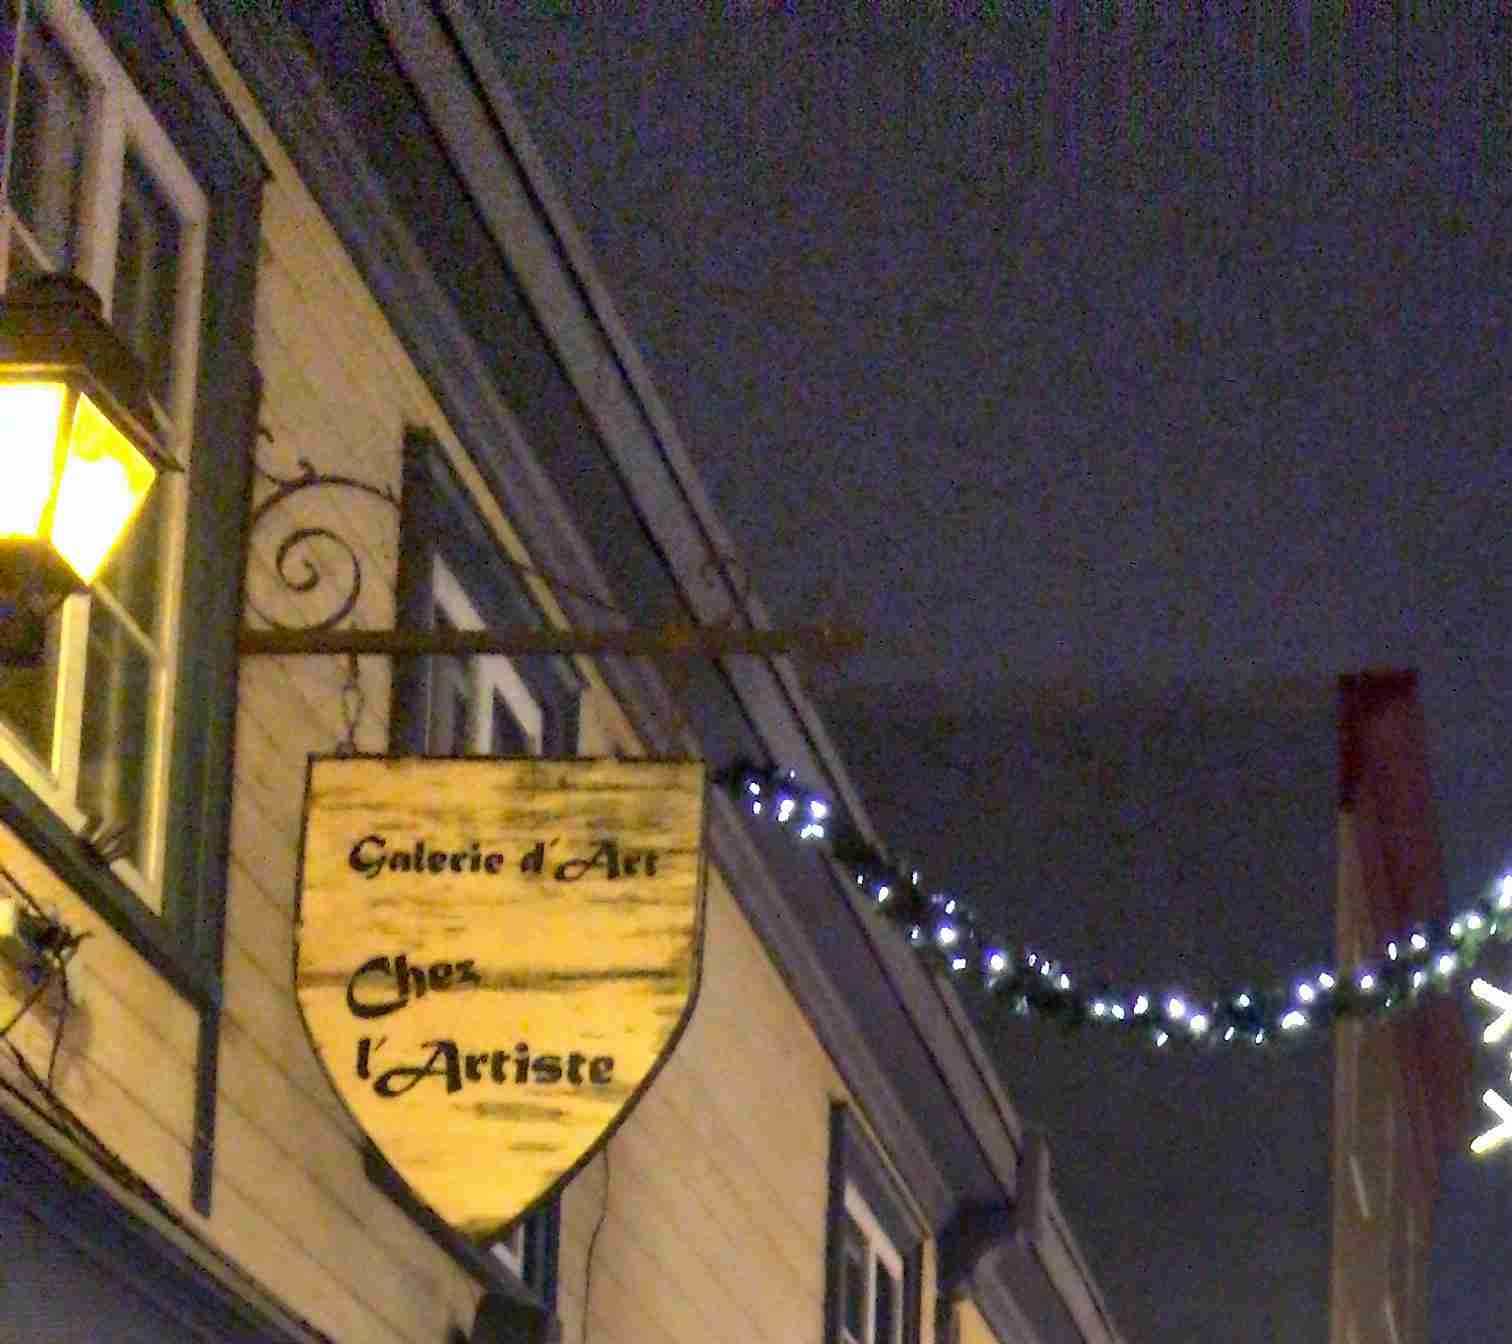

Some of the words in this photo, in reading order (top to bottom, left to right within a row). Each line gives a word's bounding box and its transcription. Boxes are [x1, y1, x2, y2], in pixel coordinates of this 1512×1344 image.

[348, 834, 505, 879] Galerie
[520, 837, 660, 882] d'Art
[345, 953, 482, 1018] Chez
[356, 1036, 614, 1098] l'Artiste
